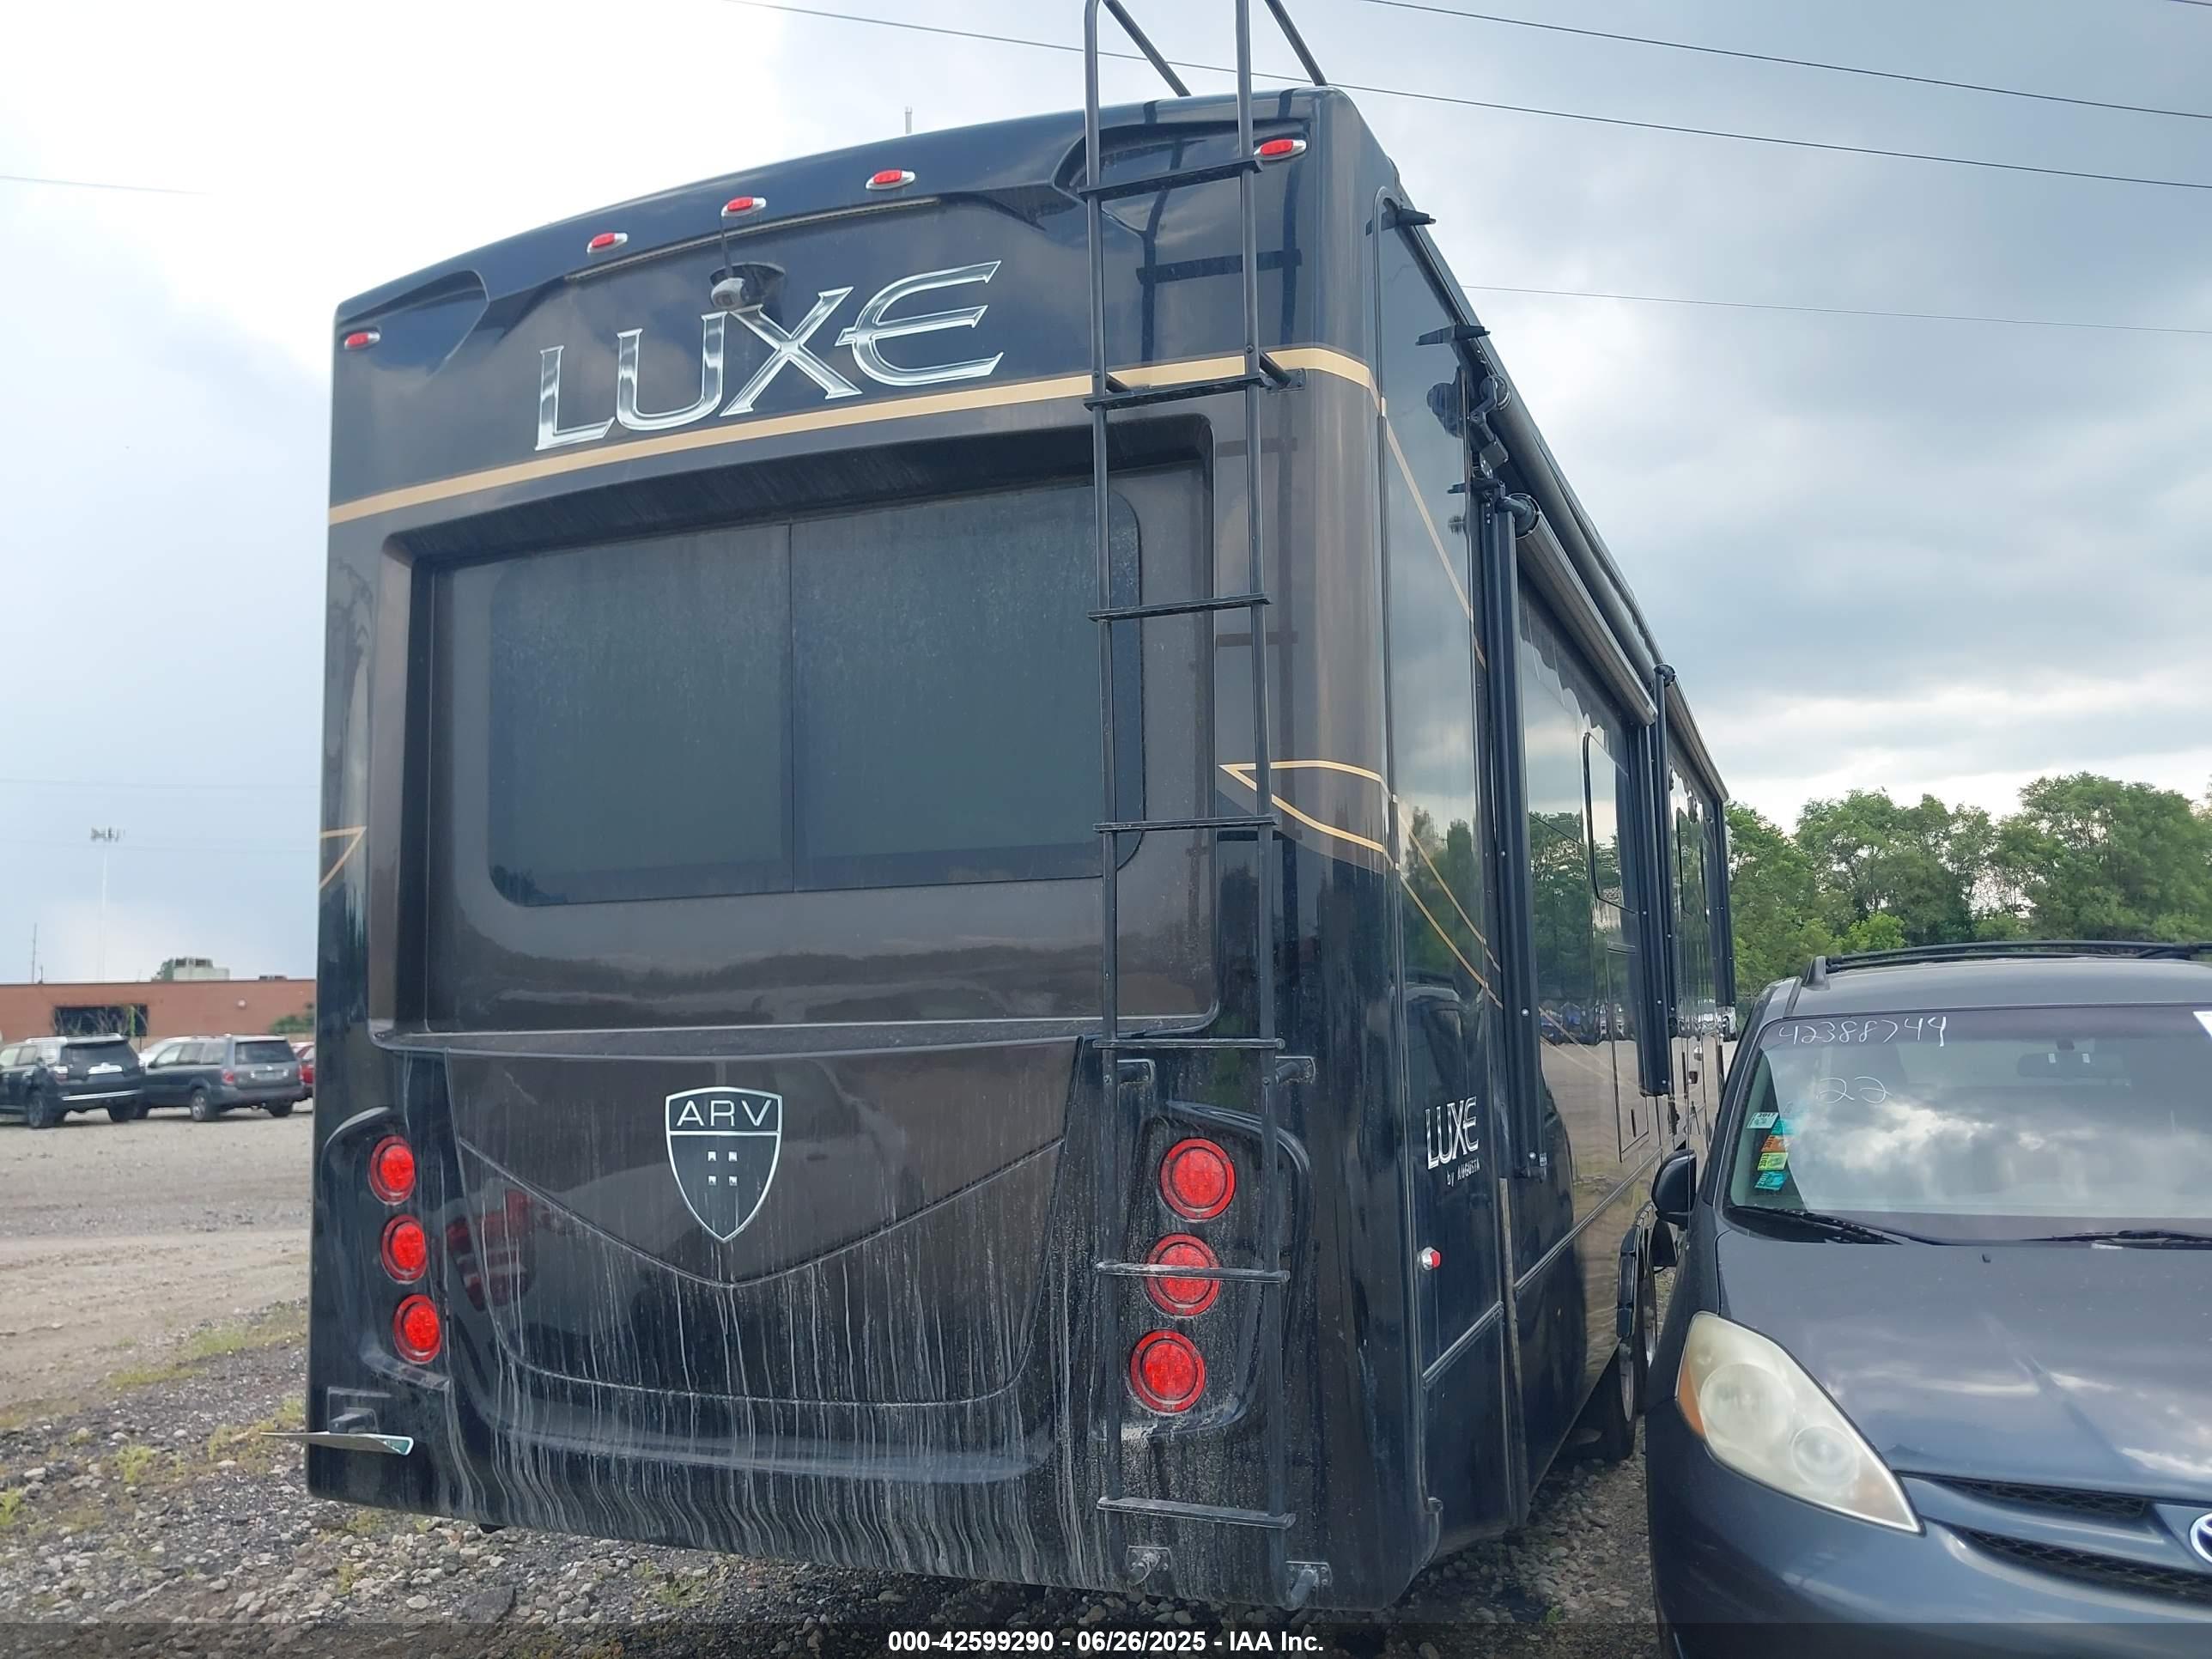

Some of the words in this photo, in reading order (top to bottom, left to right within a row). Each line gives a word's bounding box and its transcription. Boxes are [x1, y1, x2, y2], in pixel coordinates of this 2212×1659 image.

[535, 260, 1004, 451] LUXE
[677, 1100, 772, 1127] ARV
[1425, 1096, 1480, 1170] LUXE
[1446, 1169, 1455, 1187] by
